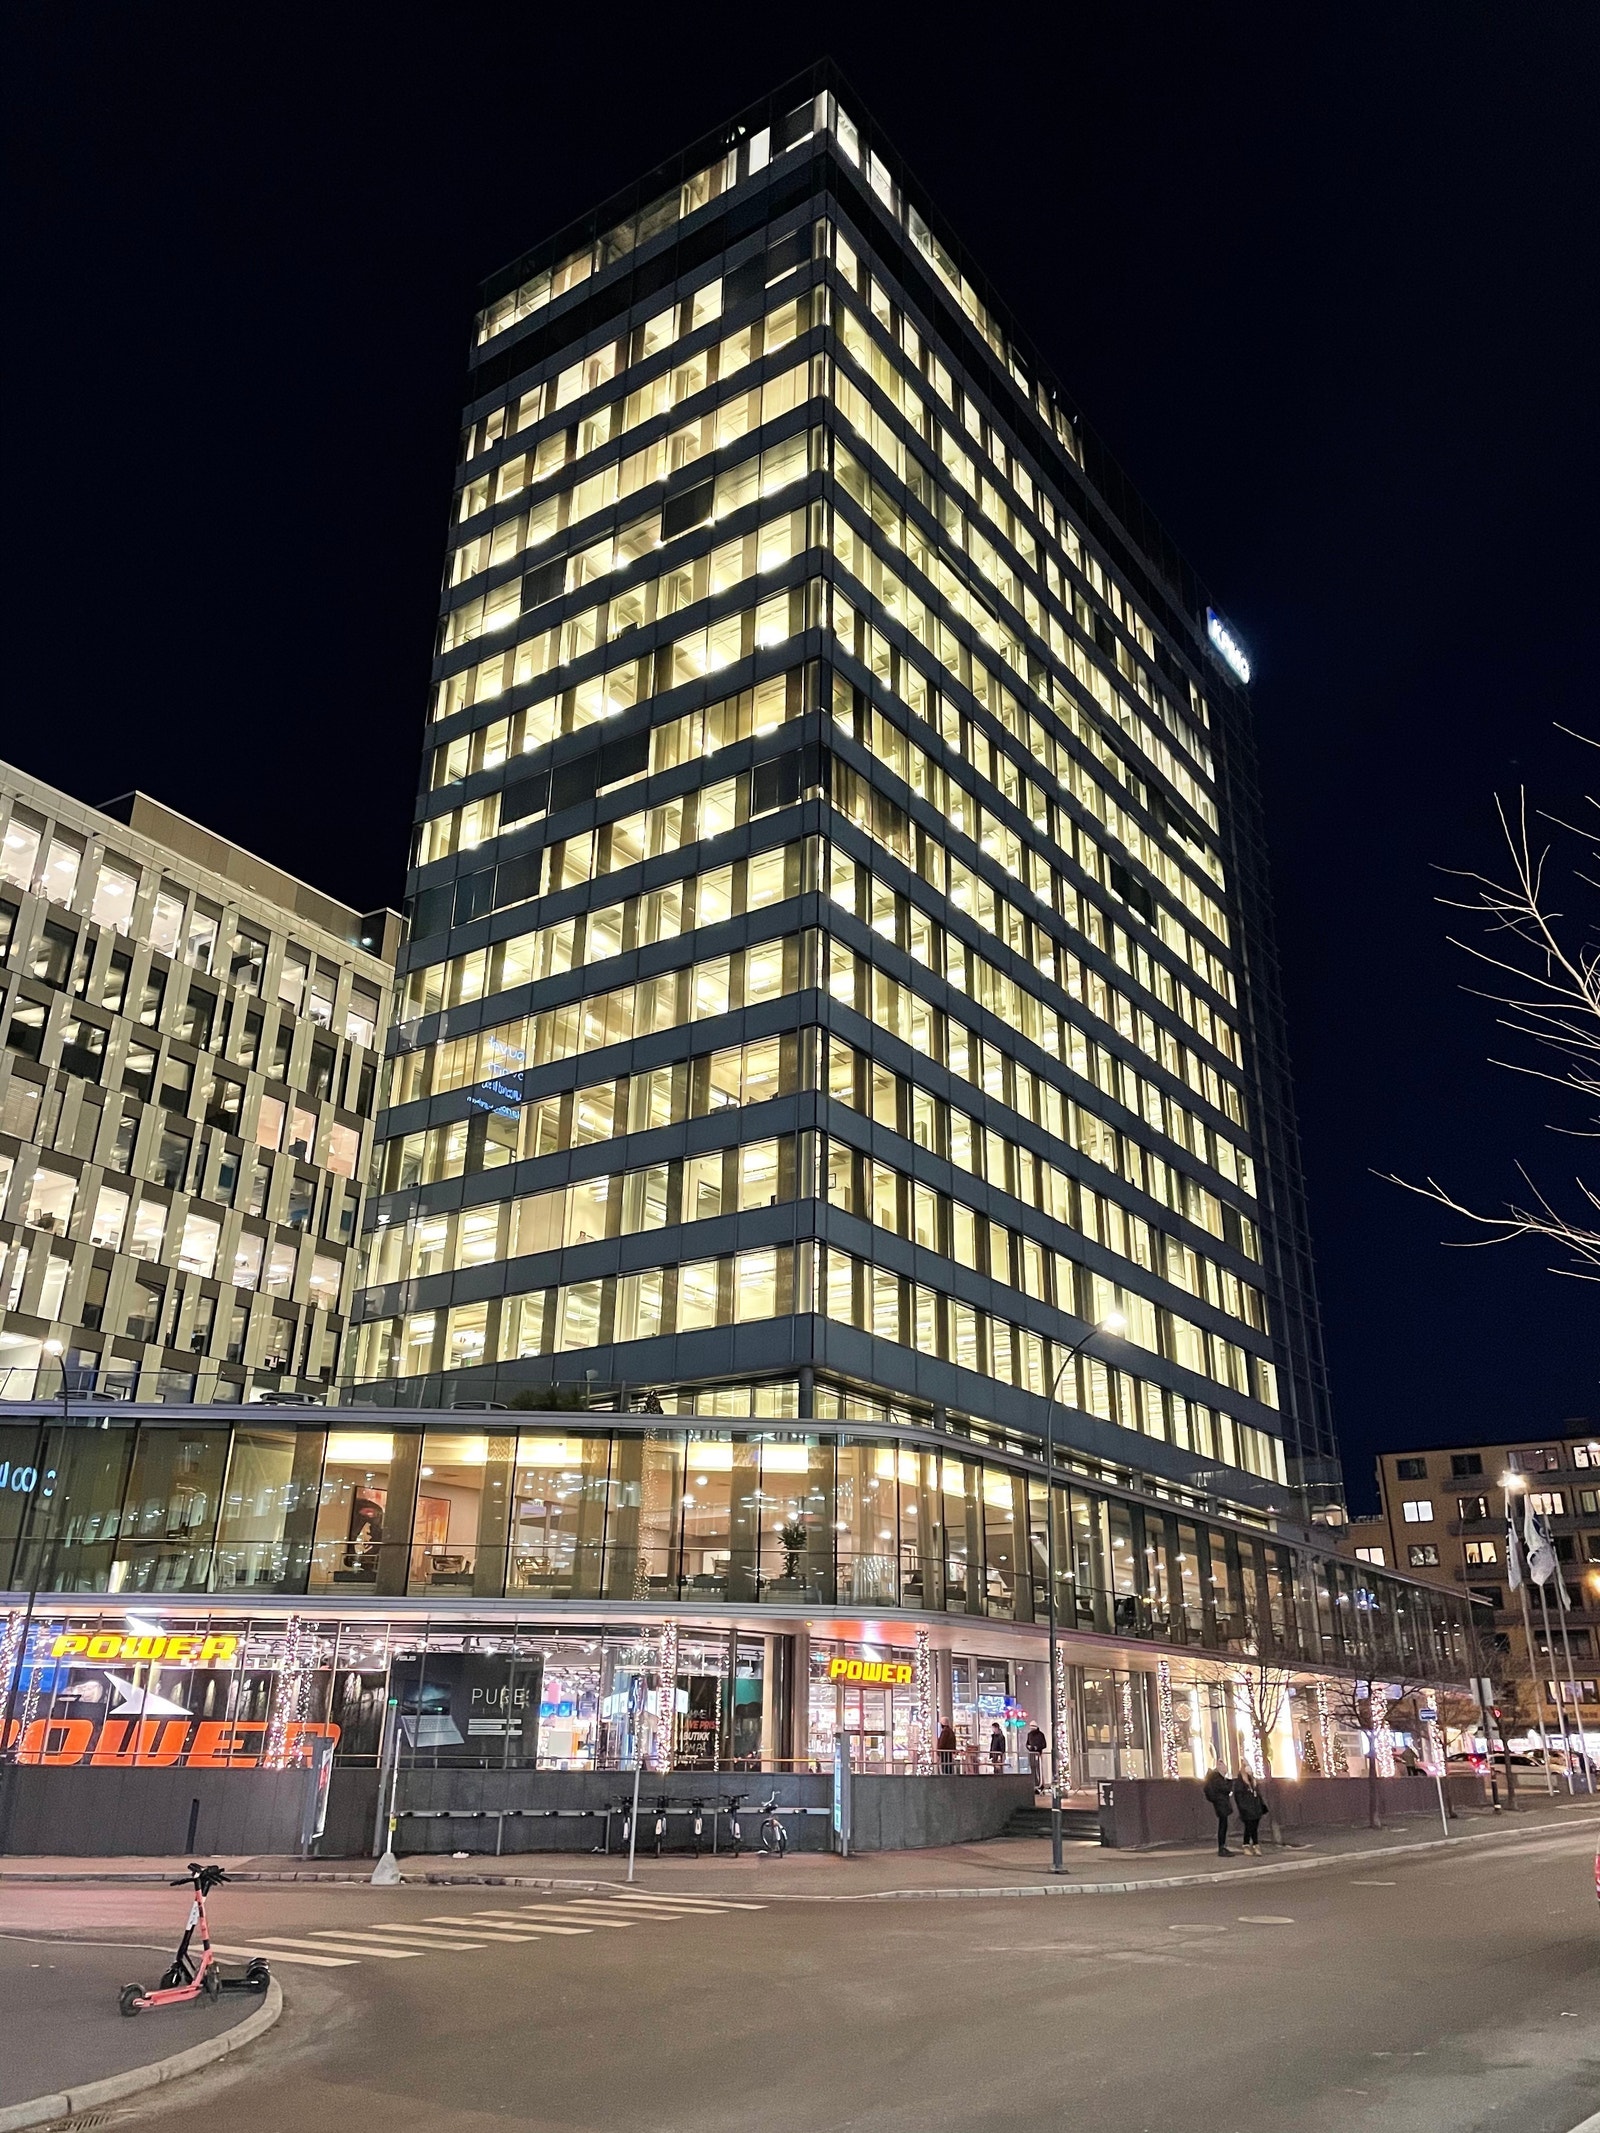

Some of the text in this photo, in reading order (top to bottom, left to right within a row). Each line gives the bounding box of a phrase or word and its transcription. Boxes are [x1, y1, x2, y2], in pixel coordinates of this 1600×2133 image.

[51, 1634, 239, 1660] POWER
[830, 1658, 912, 1684] POWER
[0, 1718, 341, 1768] OWER
[683, 1731, 710, 1741] BUTIKK
